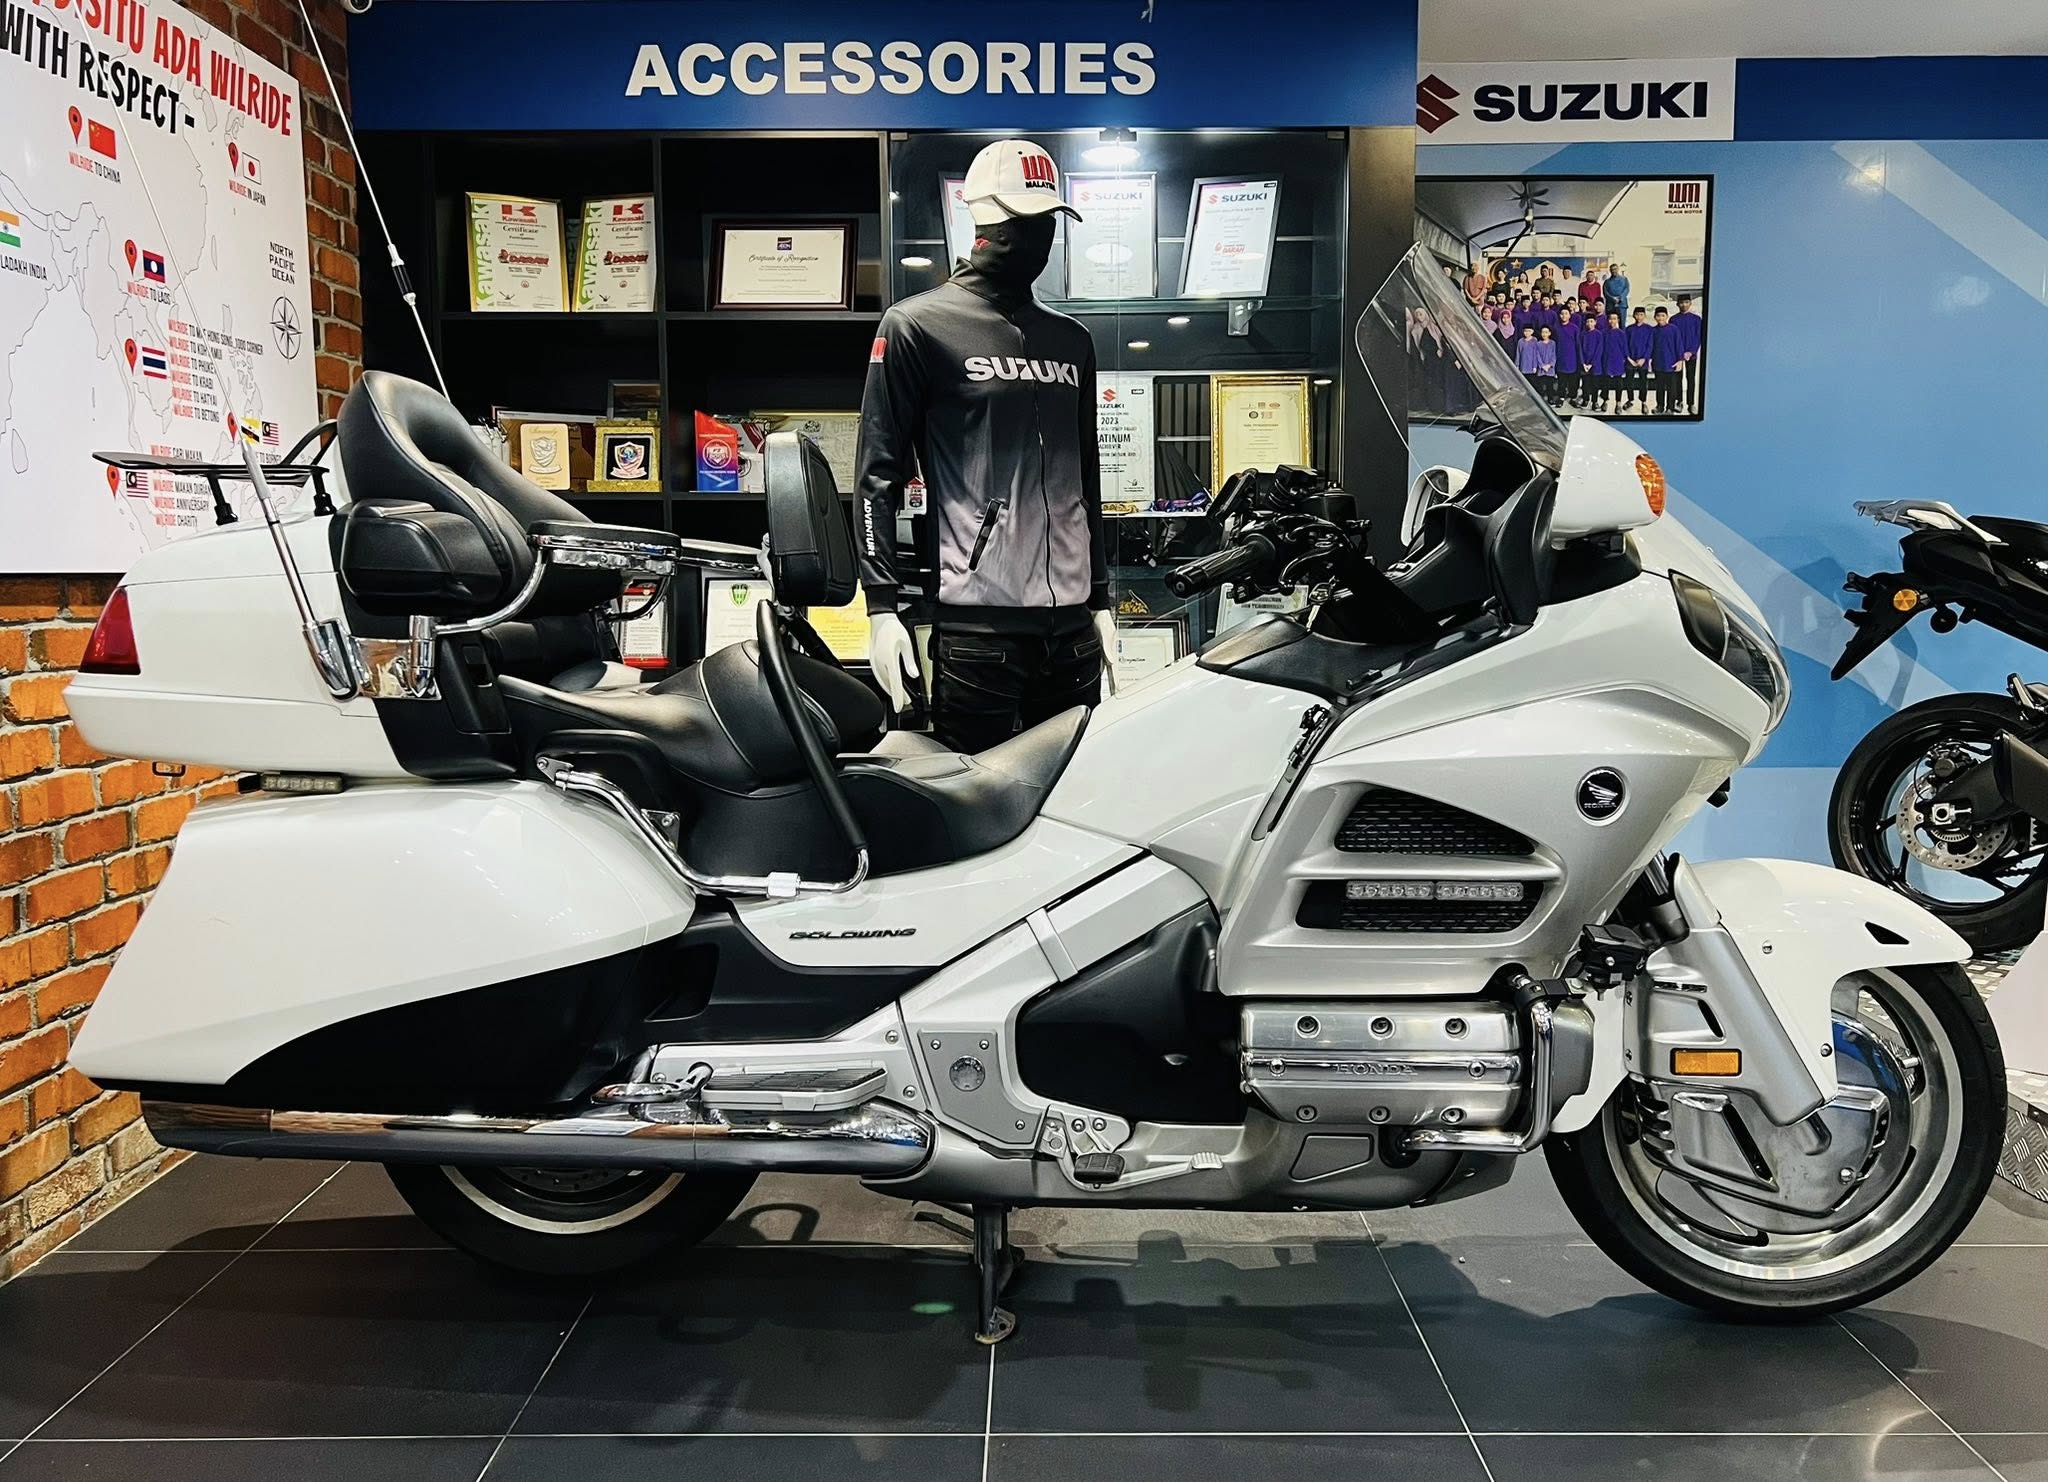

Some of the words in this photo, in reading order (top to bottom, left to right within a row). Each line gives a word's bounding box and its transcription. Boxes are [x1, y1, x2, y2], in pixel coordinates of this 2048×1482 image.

[0, 1, 69, 79] WITH
[55, 0, 145, 54] SITU
[153, 17, 201, 87] ADA
[210, 50, 292, 136] WILRIDE
[625, 42, 1156, 96] ACCESSORIES
[1473, 81, 1708, 121] SUZUKI
[103, 165, 121, 184] CHINA
[252, 190, 266, 206] JAPAN
[1095, 191, 1143, 200] SUZUKI
[1221, 192, 1268, 203] SUZUKI
[502, 216, 538, 224] Kawasaki
[502, 225, 539, 234] Certificate
[611, 225, 643, 233] Certificate
[270, 241, 293, 259] NORTH
[0, 255, 28, 275] LADAKH
[29, 262, 47, 280] INDIA
[269, 254, 295, 272] PACIFIC
[272, 268, 295, 284] OCEAN
[157, 290, 171, 305] LAOS
[964, 356, 1080, 388] SUZUKI
[1101, 416, 1119, 425] 2023
[1098, 433, 1131, 443] ATINUM
[176, 499, 209, 511] ANNIVERSARY
[177, 515, 198, 527] CHARITY
[863, 497, 876, 557] ADVENTURE
[1335, 1063, 1419, 1076] HONDA
